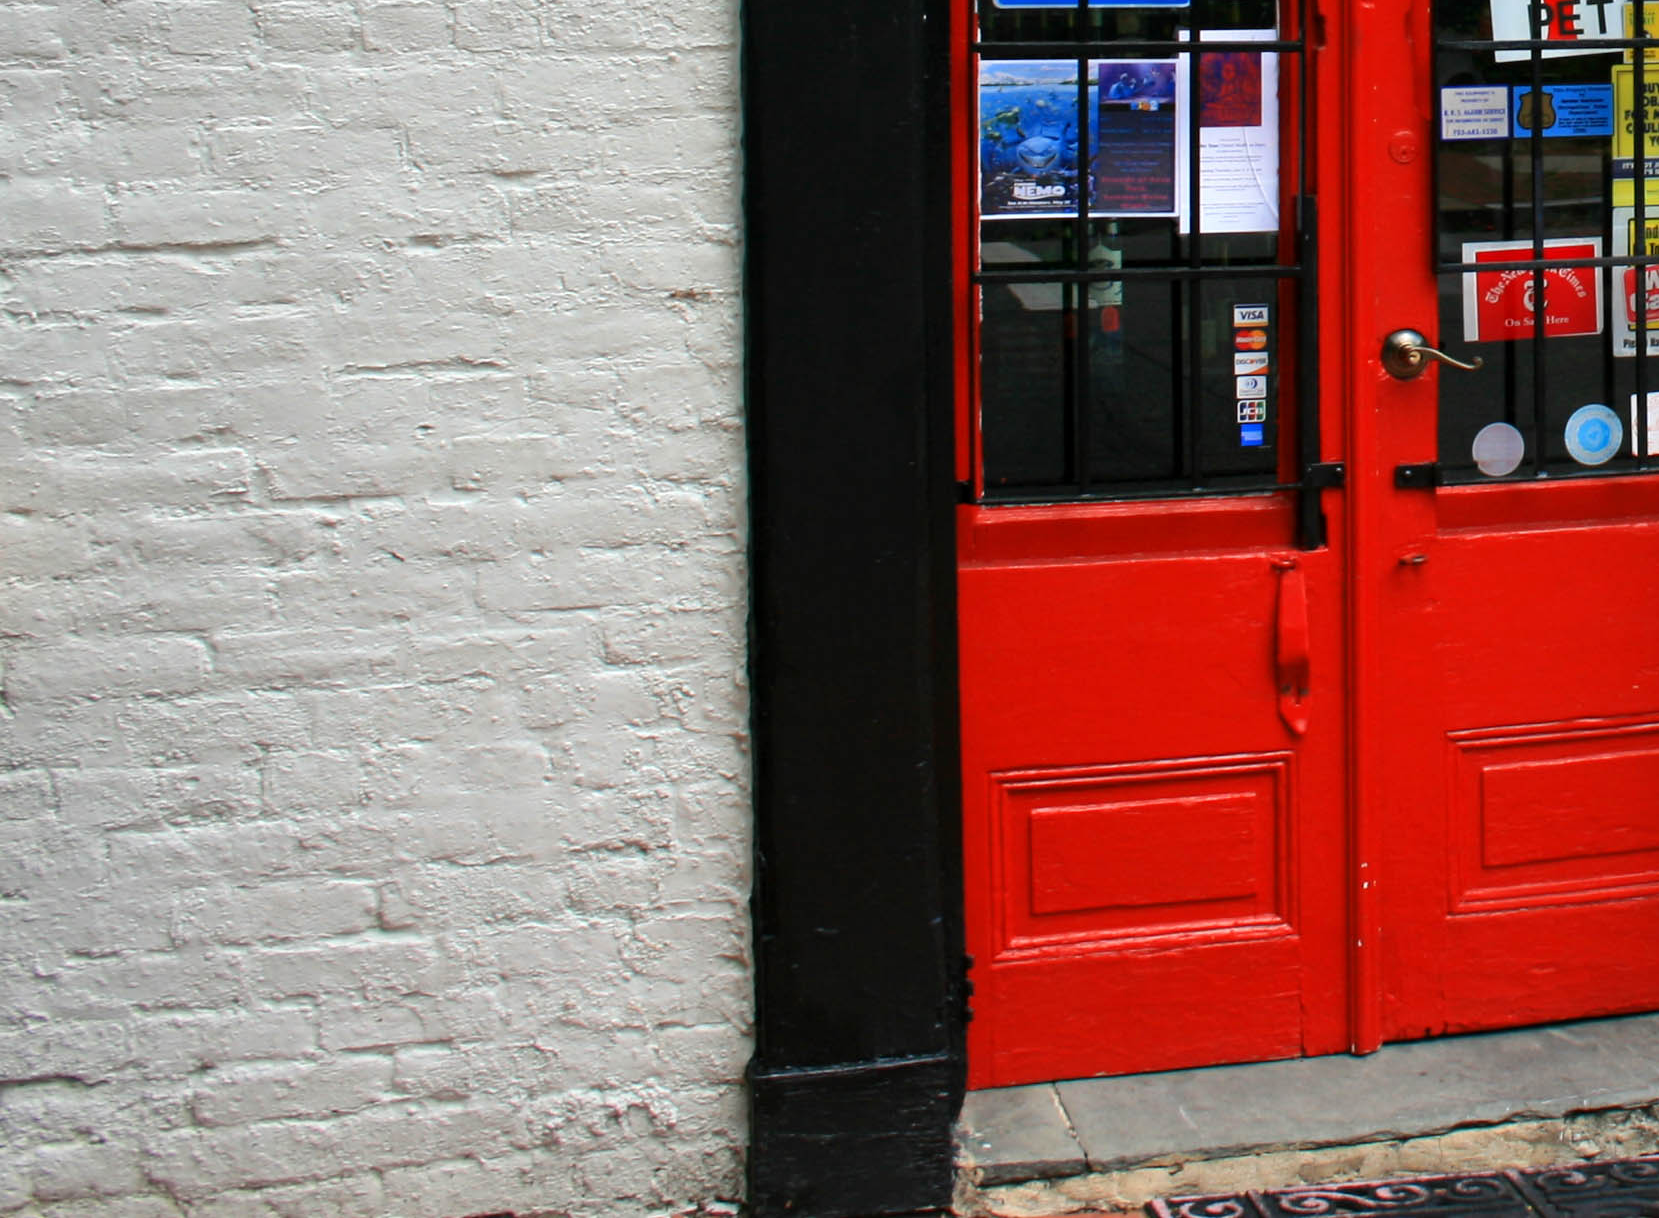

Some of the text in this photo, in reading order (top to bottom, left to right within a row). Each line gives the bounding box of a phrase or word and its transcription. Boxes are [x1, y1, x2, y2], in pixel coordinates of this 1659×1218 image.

[1625, 109, 1649, 120] FR
[1485, 282, 1504, 303] The
[1558, 267, 1587, 298] Times
[1240, 310, 1265, 320] VISA
[1505, 318, 1520, 327] On
[1546, 315, 1569, 325] Here
